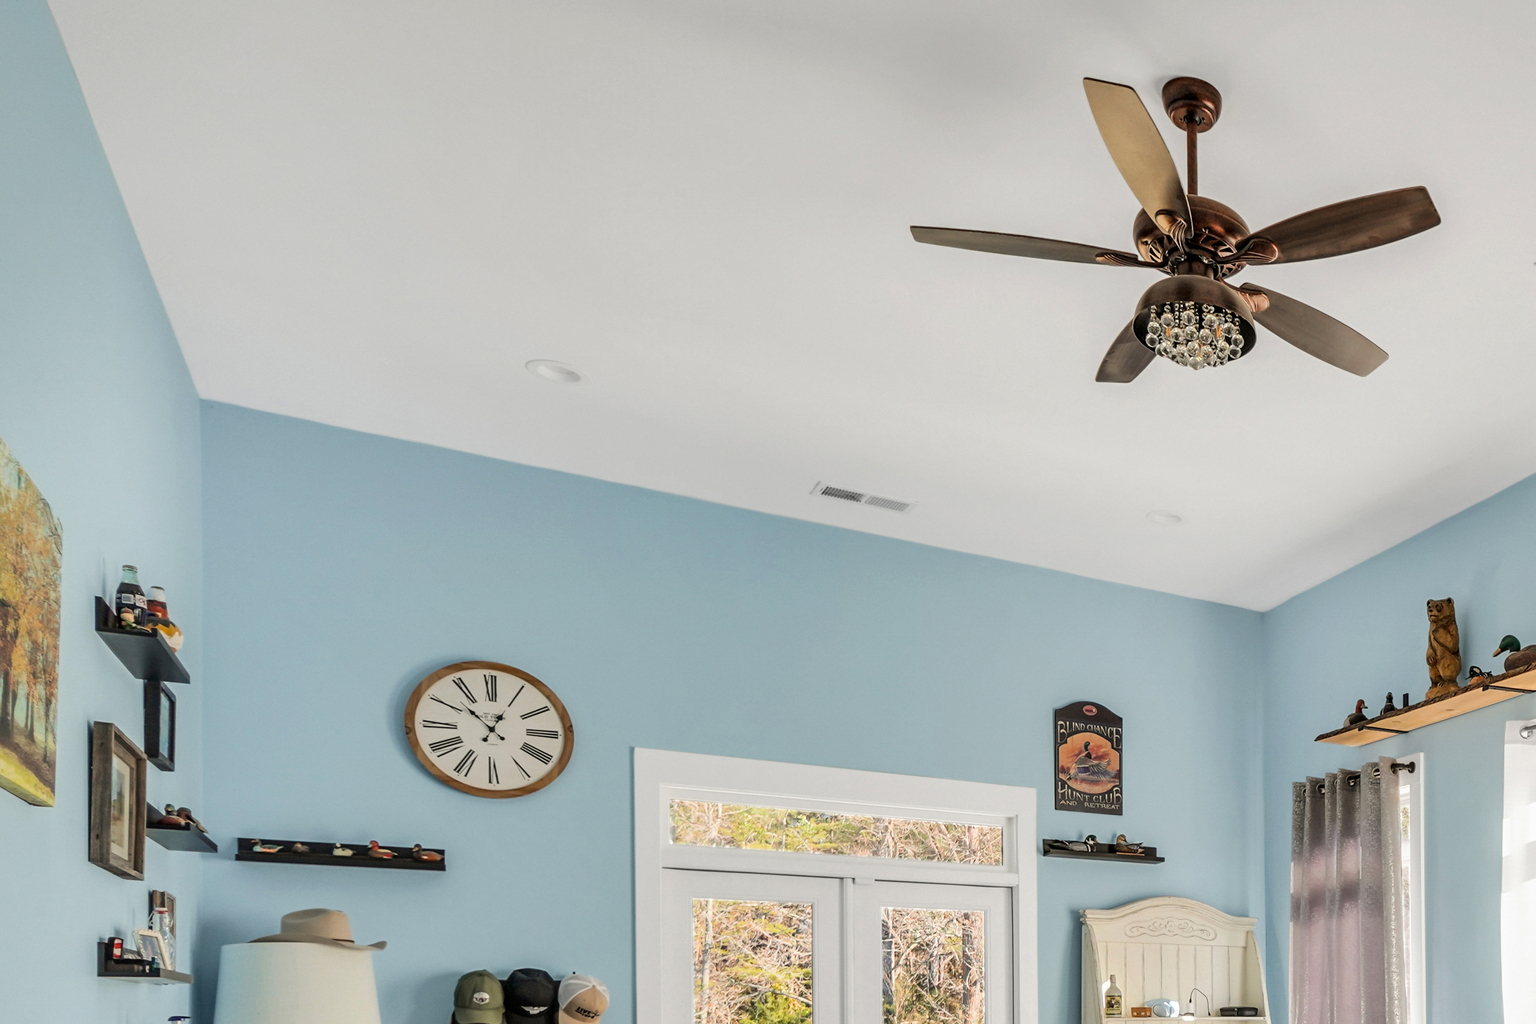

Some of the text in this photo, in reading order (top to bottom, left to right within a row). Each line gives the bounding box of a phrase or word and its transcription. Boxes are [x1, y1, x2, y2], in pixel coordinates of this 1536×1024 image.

[1057, 720, 1122, 749] BLIND CHANCE
[1058, 781, 1122, 804] HUNT CLUB
[1084, 802, 1120, 810] RETREAT
